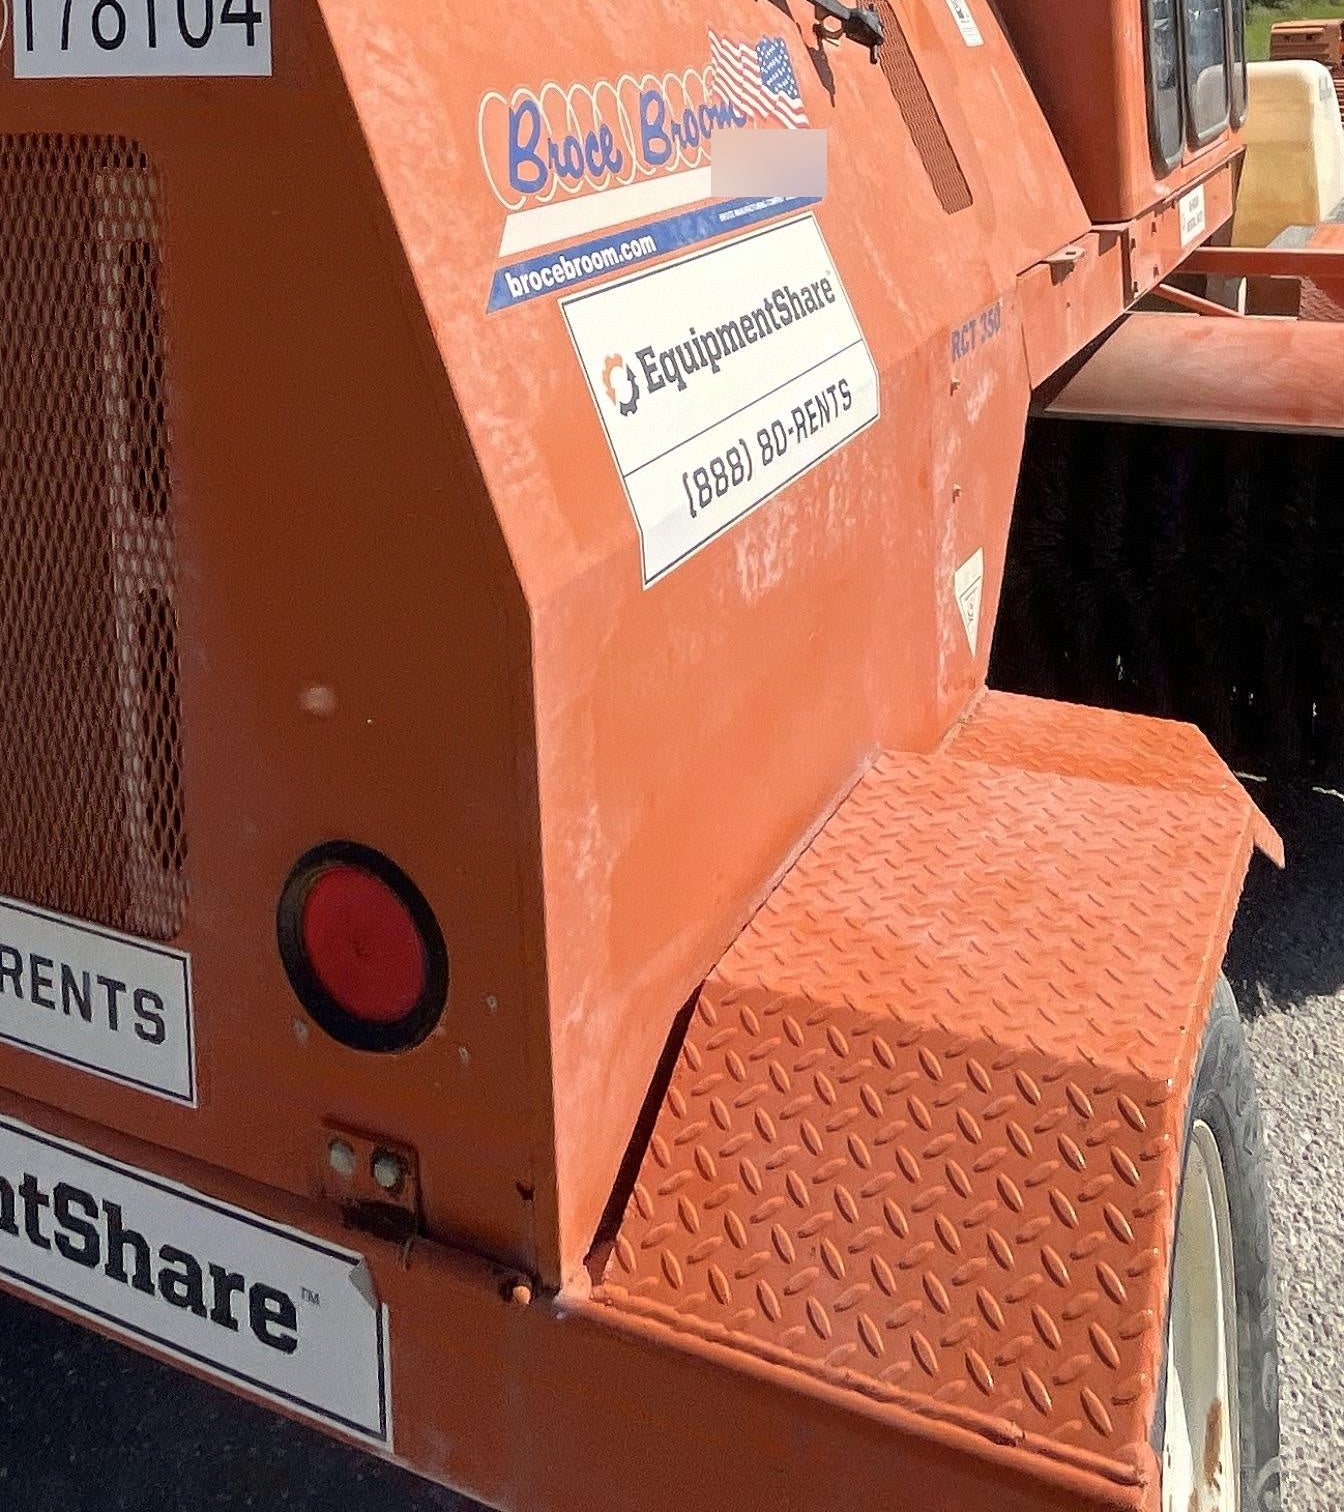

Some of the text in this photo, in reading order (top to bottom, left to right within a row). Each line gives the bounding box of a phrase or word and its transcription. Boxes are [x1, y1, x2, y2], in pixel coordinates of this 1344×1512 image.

[509, 89, 748, 194] Broce Broom
[504, 234, 658, 299] brocebroom.com
[635, 276, 837, 393] EquipmentShare
[950, 319, 977, 364] RCT
[681, 377, 853, 519] (888) 80-RENTS
